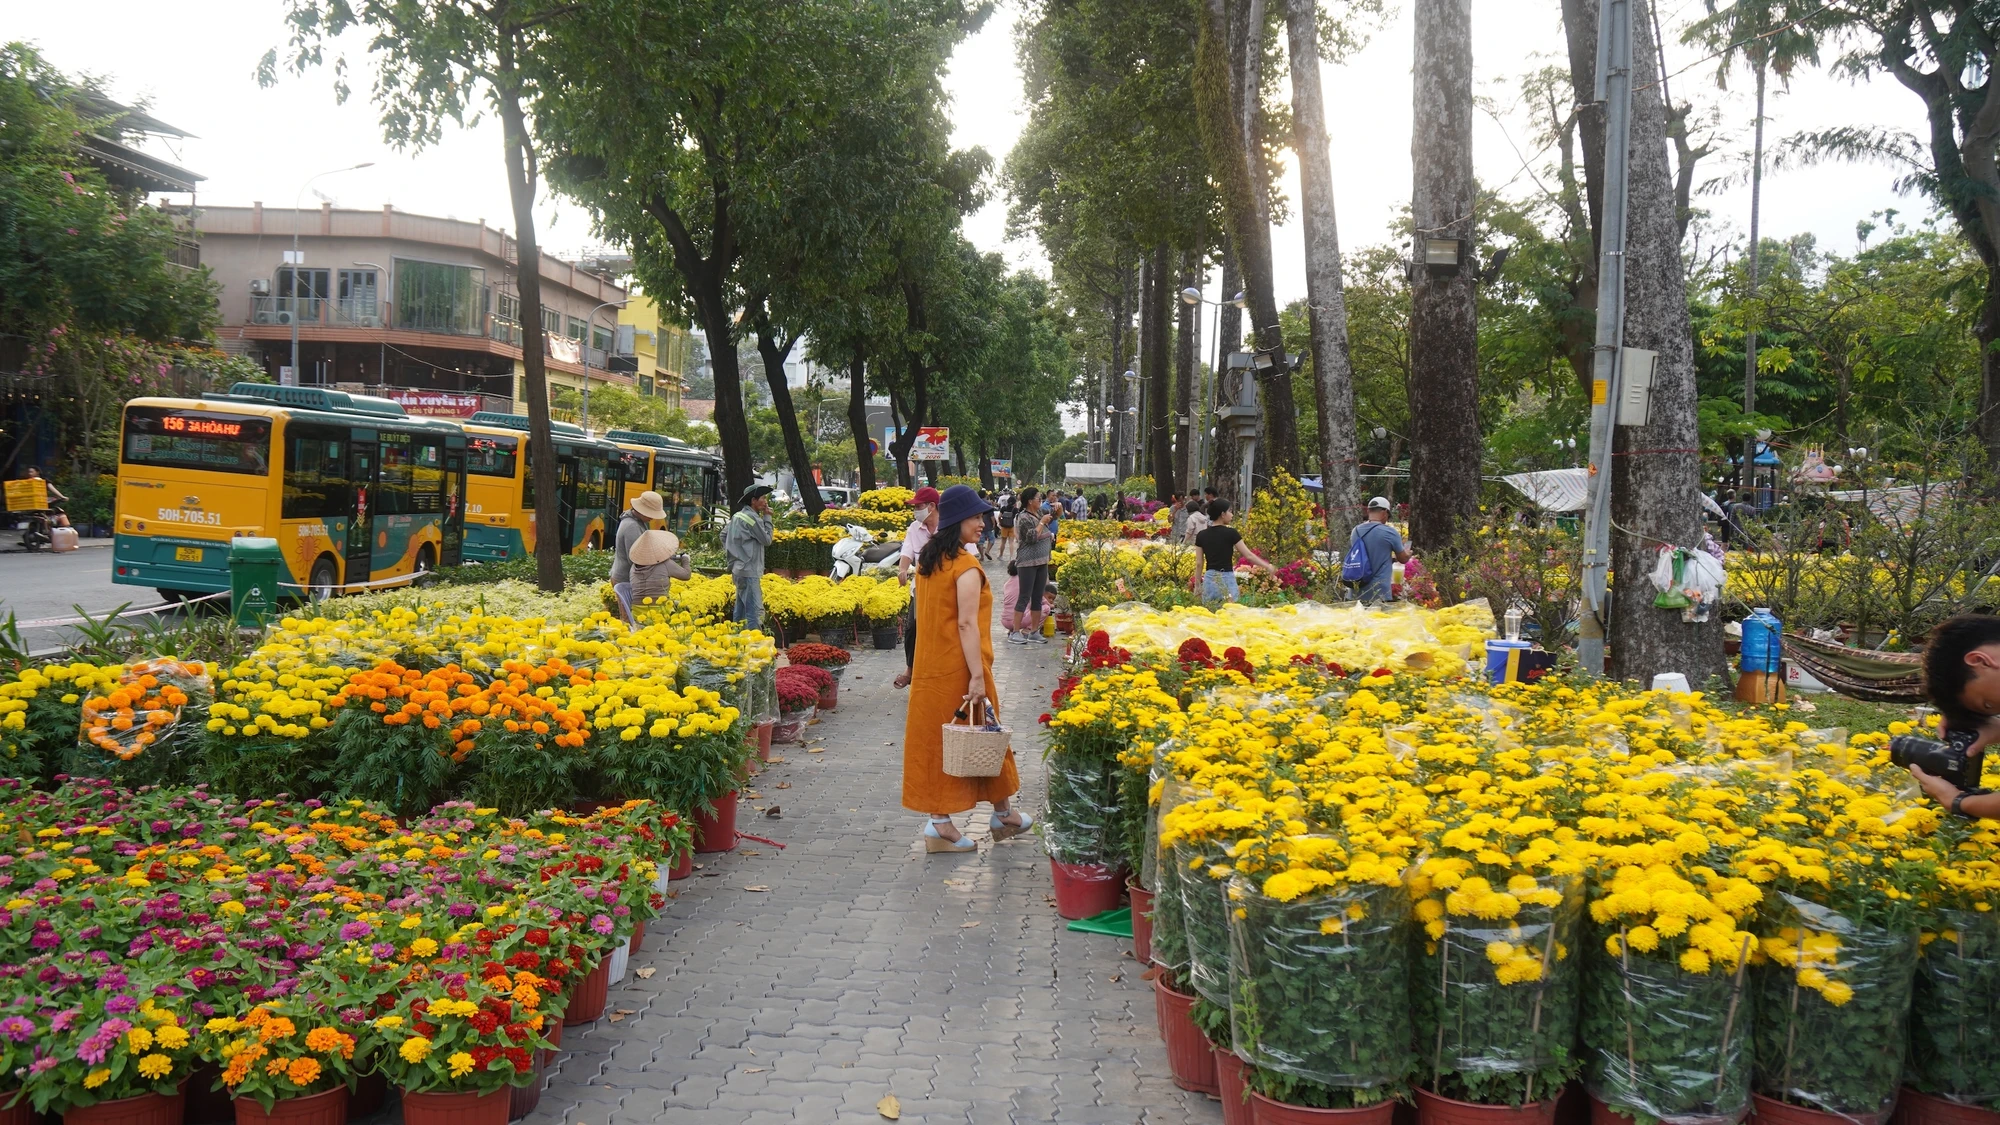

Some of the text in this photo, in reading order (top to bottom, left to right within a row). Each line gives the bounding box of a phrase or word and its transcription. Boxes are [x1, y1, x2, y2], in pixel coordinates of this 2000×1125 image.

[419, 394, 456, 406] XUYÊN
[458, 396, 477, 406] TẾT
[162, 416, 185, 431] 156
[158, 508, 221, 526] 50H-705.51
